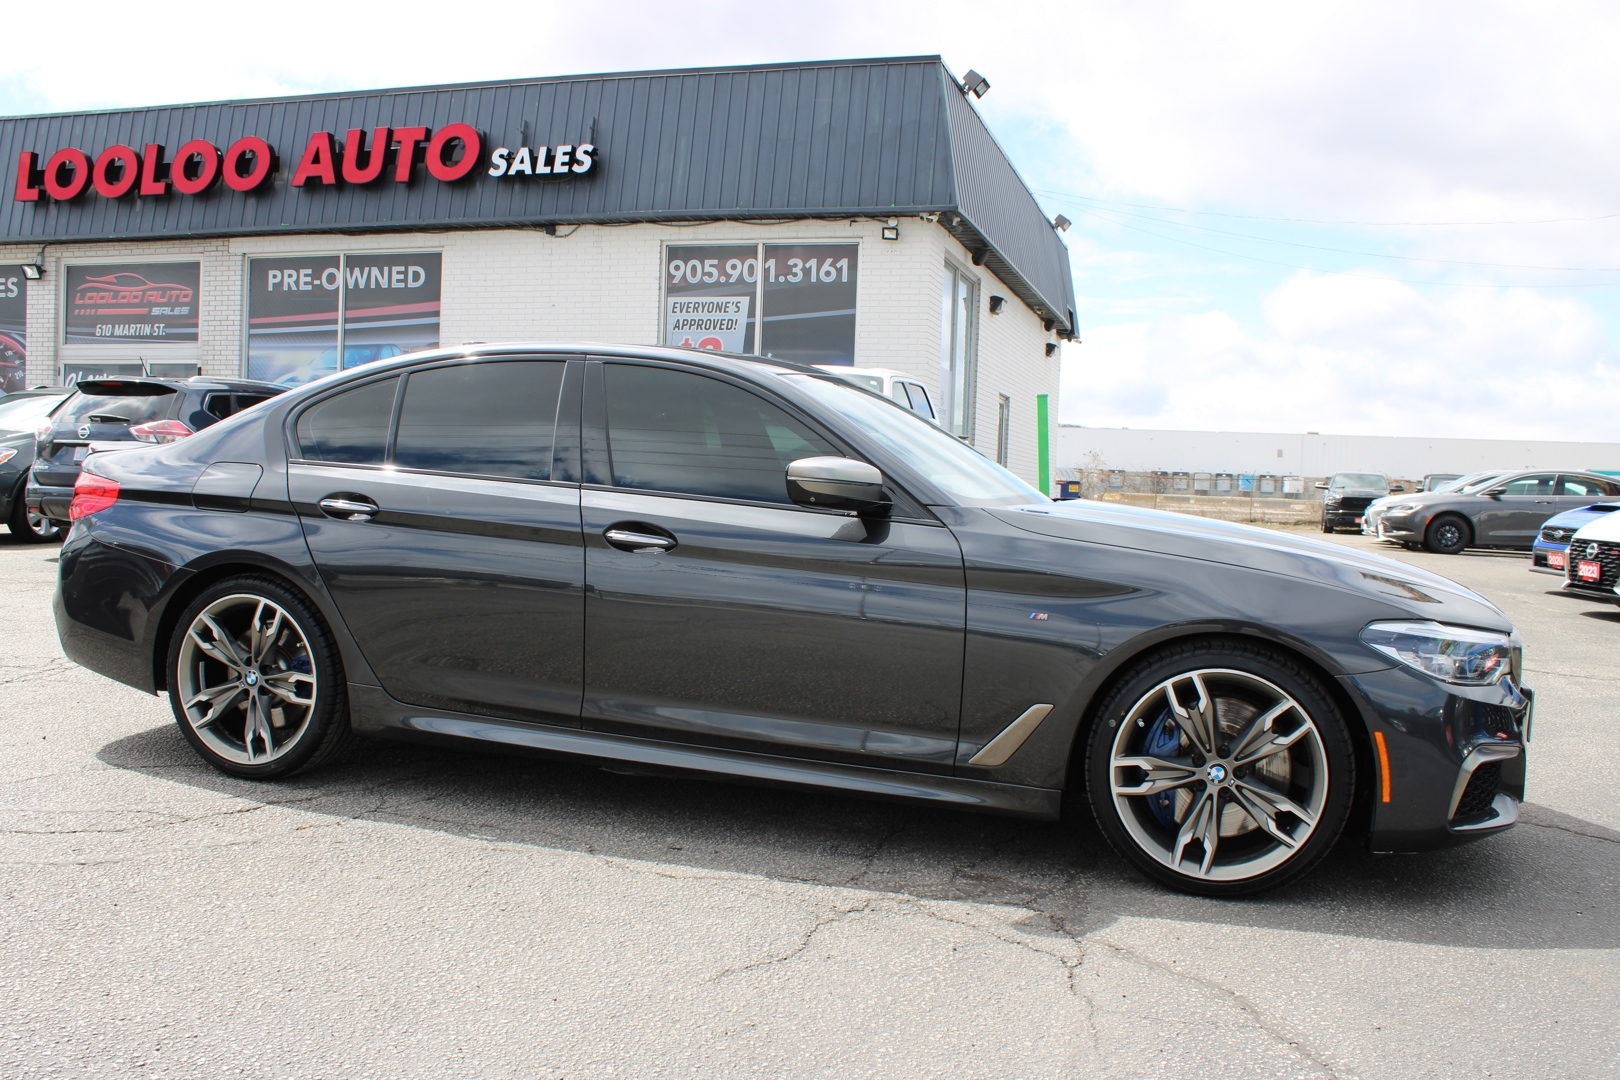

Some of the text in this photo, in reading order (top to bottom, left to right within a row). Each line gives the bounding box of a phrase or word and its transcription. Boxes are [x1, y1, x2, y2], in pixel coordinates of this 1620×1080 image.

[15, 122, 595, 202] LOOLOO AUTO SALES
[669, 258, 849, 284] 905.901.3161
[268, 265, 426, 291] PRE-OWNED
[74, 290, 193, 304] LOOLOO AUTO
[151, 306, 190, 315] SALES
[671, 301, 741, 314] EVERYONE'S
[95, 323, 166, 336] 610 MARTIN ST.
[673, 318, 738, 331] APPROVED!
[1548, 555, 1563, 566] 2020
[1578, 564, 1598, 578] 2023
